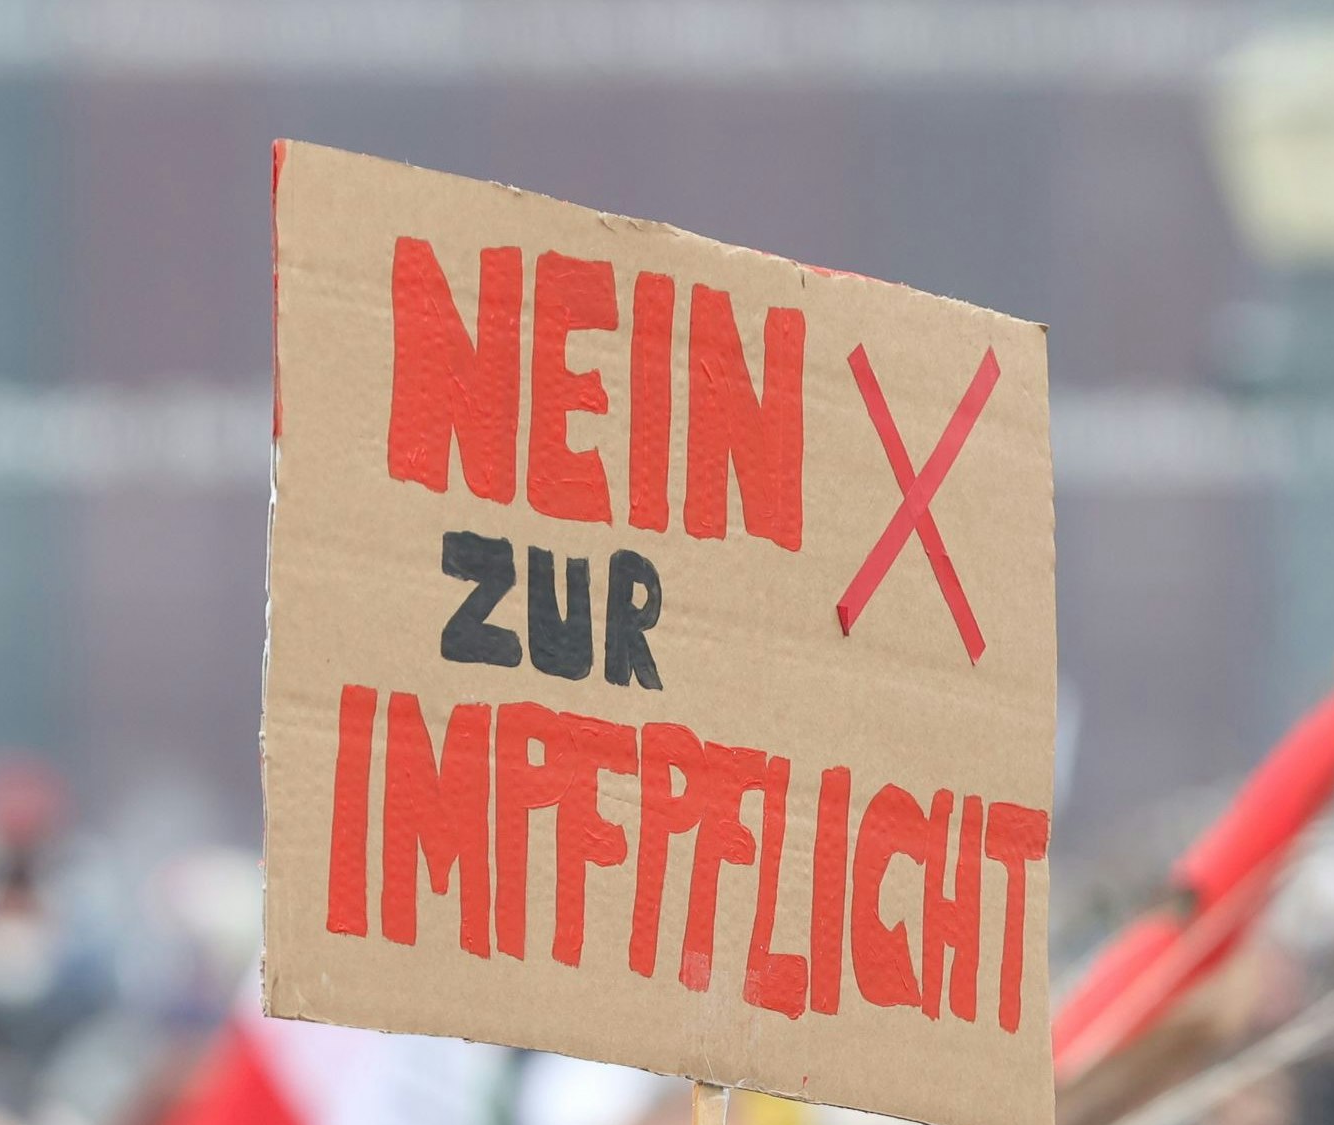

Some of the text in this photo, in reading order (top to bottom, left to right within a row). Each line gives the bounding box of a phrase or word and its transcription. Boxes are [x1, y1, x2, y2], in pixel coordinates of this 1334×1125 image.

[387, 236, 806, 552] NEIN
[440, 531, 664, 691] ZUR
[326, 684, 1049, 1033] IMPFPFLICHT
